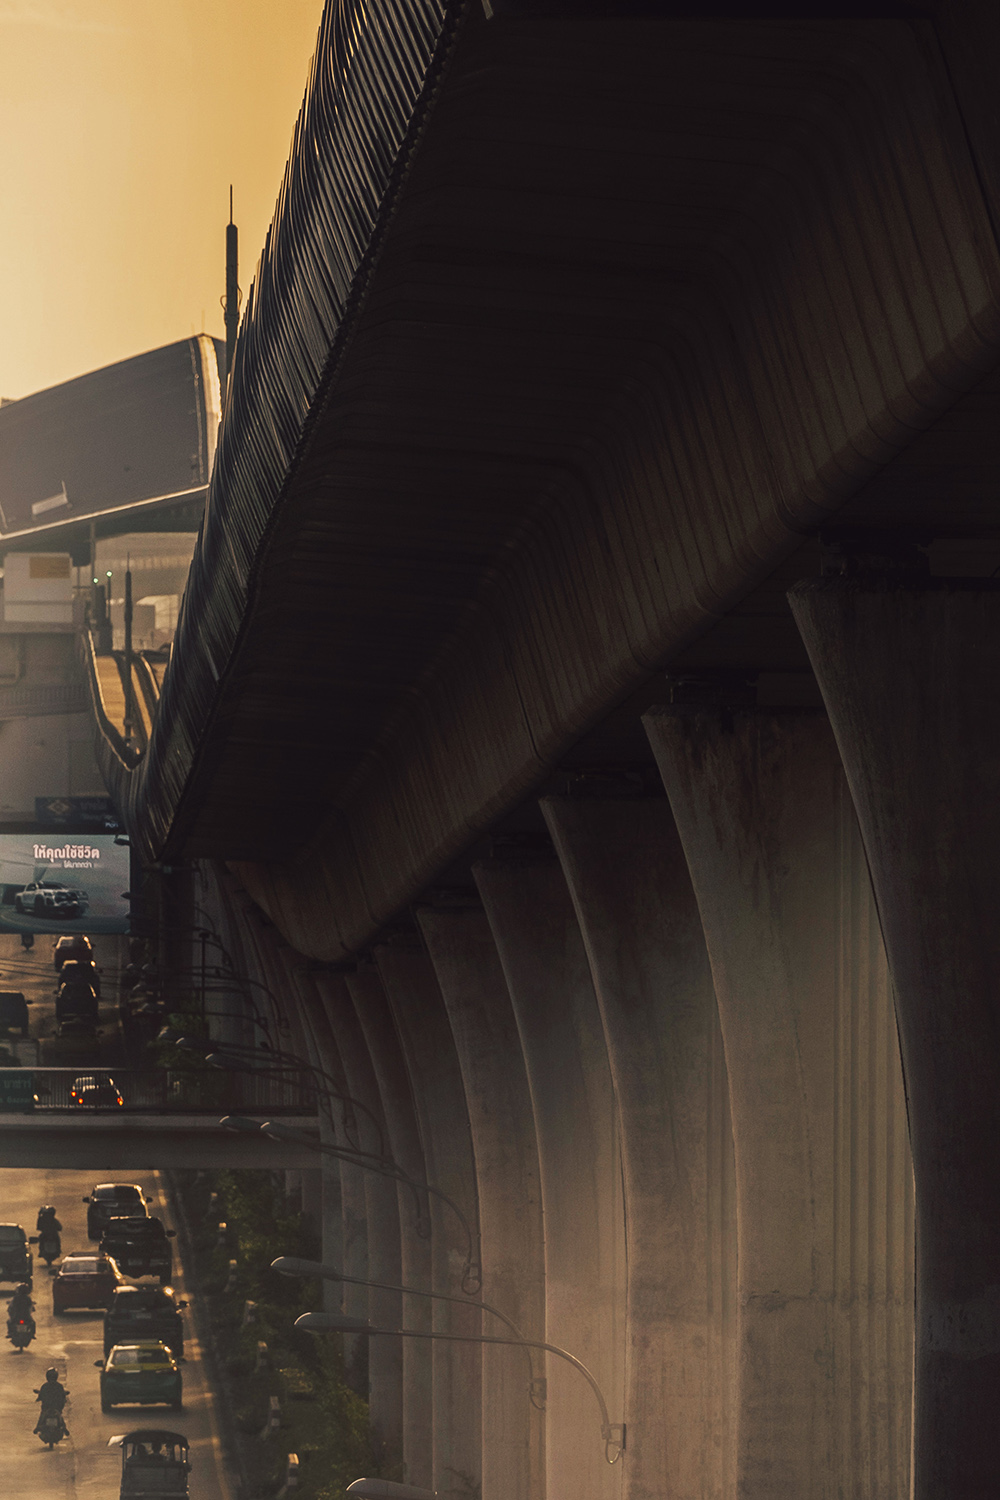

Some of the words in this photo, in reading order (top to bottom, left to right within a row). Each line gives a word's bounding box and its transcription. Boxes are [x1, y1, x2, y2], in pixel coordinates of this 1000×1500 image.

[33, 843, 100, 863] ให้คุณใช้ชีวิต
